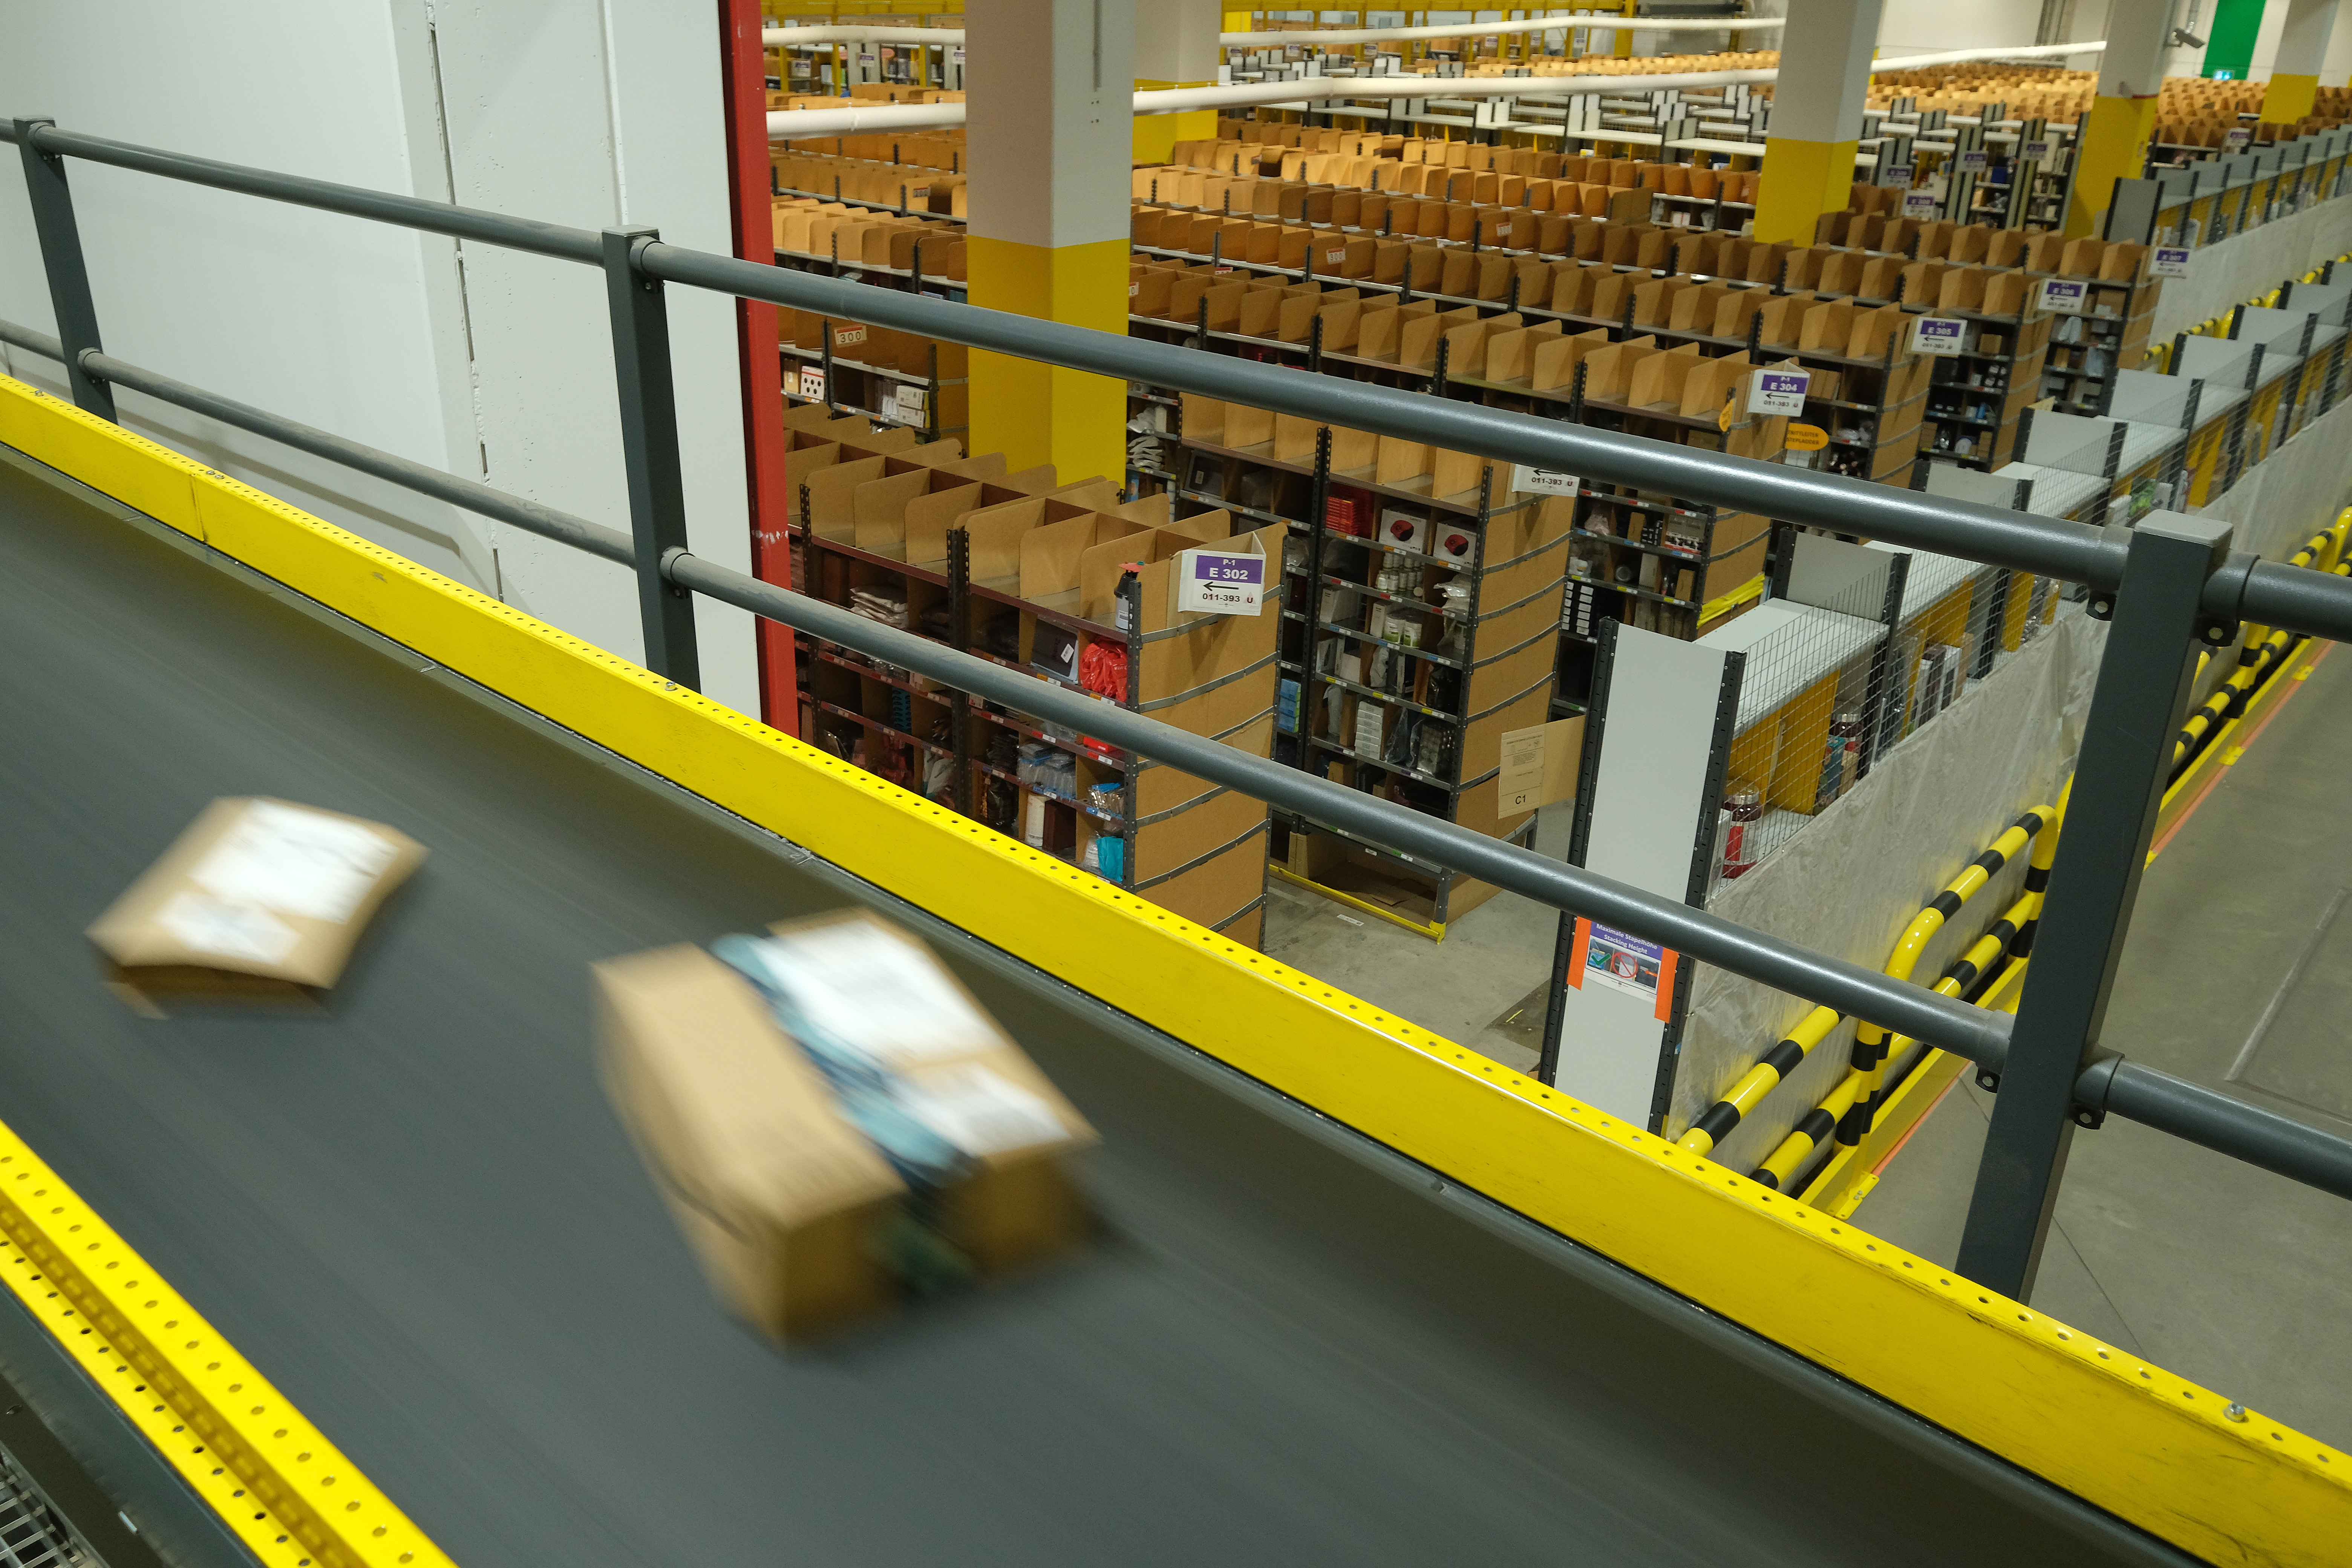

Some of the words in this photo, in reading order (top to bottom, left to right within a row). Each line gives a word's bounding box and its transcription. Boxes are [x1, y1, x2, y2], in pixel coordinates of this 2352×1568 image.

[840, 331, 861, 343] 300
[1779, 383, 1798, 392] 304
[1531, 477, 1562, 485] 011-393
[1209, 567, 1219, 577] E
[1222, 568, 1248, 580] 302
[1202, 593, 1240, 602] 011-393
[1515, 794, 1526, 804] C1
[1596, 923, 1624, 938] Maximale
[1625, 934, 1658, 950] Stapelhöhe
[1604, 934, 1628, 948] Stacking
[1628, 943, 1648, 954] Height
